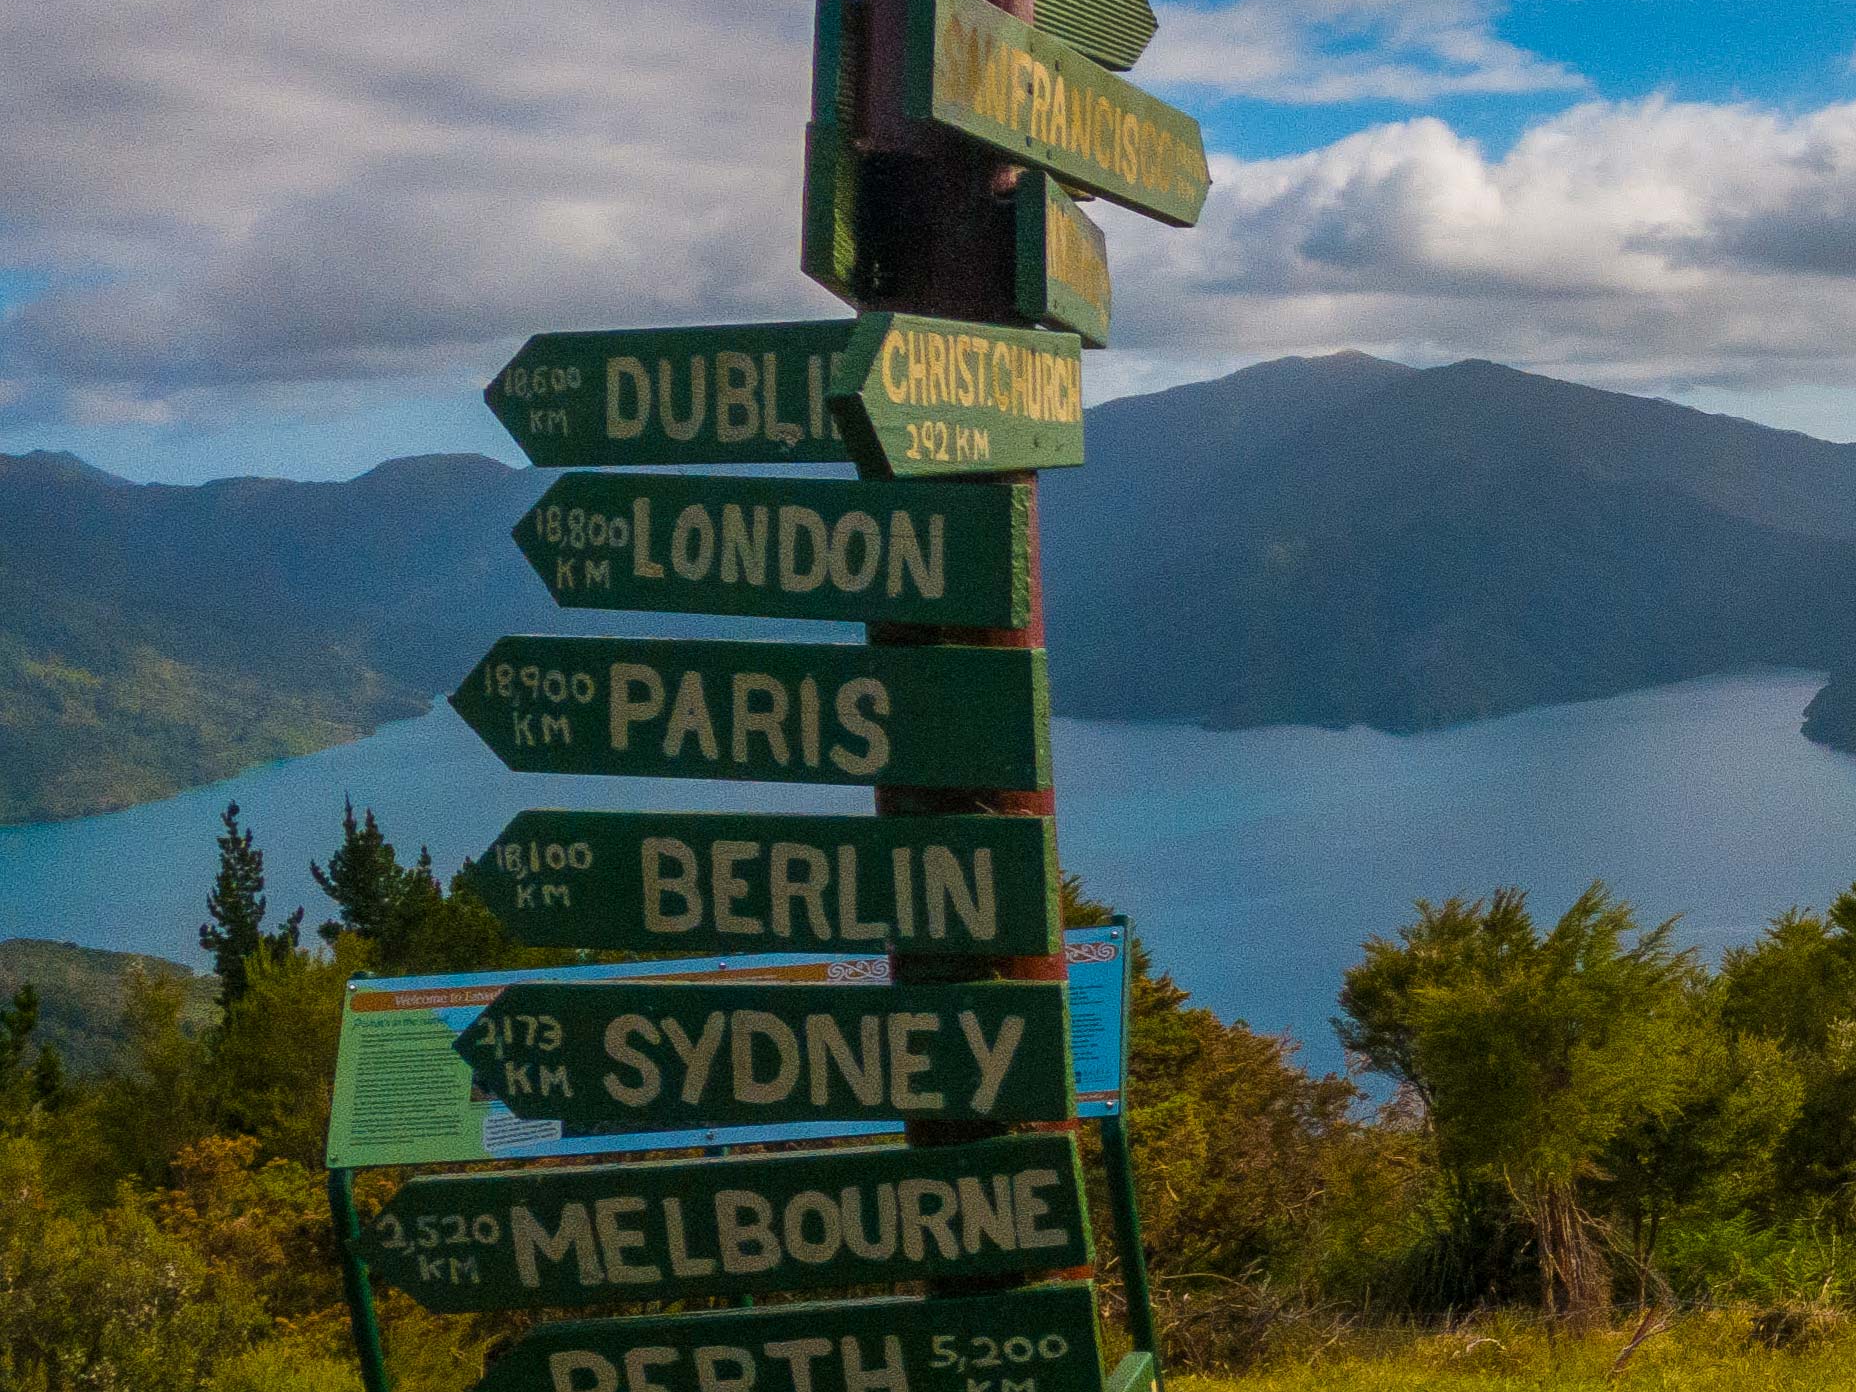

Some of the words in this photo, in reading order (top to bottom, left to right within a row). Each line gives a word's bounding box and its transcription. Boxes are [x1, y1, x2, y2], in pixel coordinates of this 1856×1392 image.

[606, 351, 850, 447] DUBLI
[530, 408, 568, 437] KM
[906, 421, 949, 461] 292
[955, 424, 989, 461] KM
[536, 505, 629, 550] 18,800
[632, 497, 946, 600] LONDON
[556, 558, 611, 589] KM
[512, 711, 573, 747] KM
[609, 663, 892, 776] PARIS
[516, 884, 571, 908] KM
[641, 837, 996, 941] BERLIN
[504, 1061, 574, 1098] KM
[602, 1009, 1024, 1115] SYDNEY
[376, 1214, 500, 1255] 2,520
[513, 1170, 1069, 1290] MELBOURNE
[417, 1255, 481, 1285] KM
[930, 1334, 1068, 1373] 5,200
